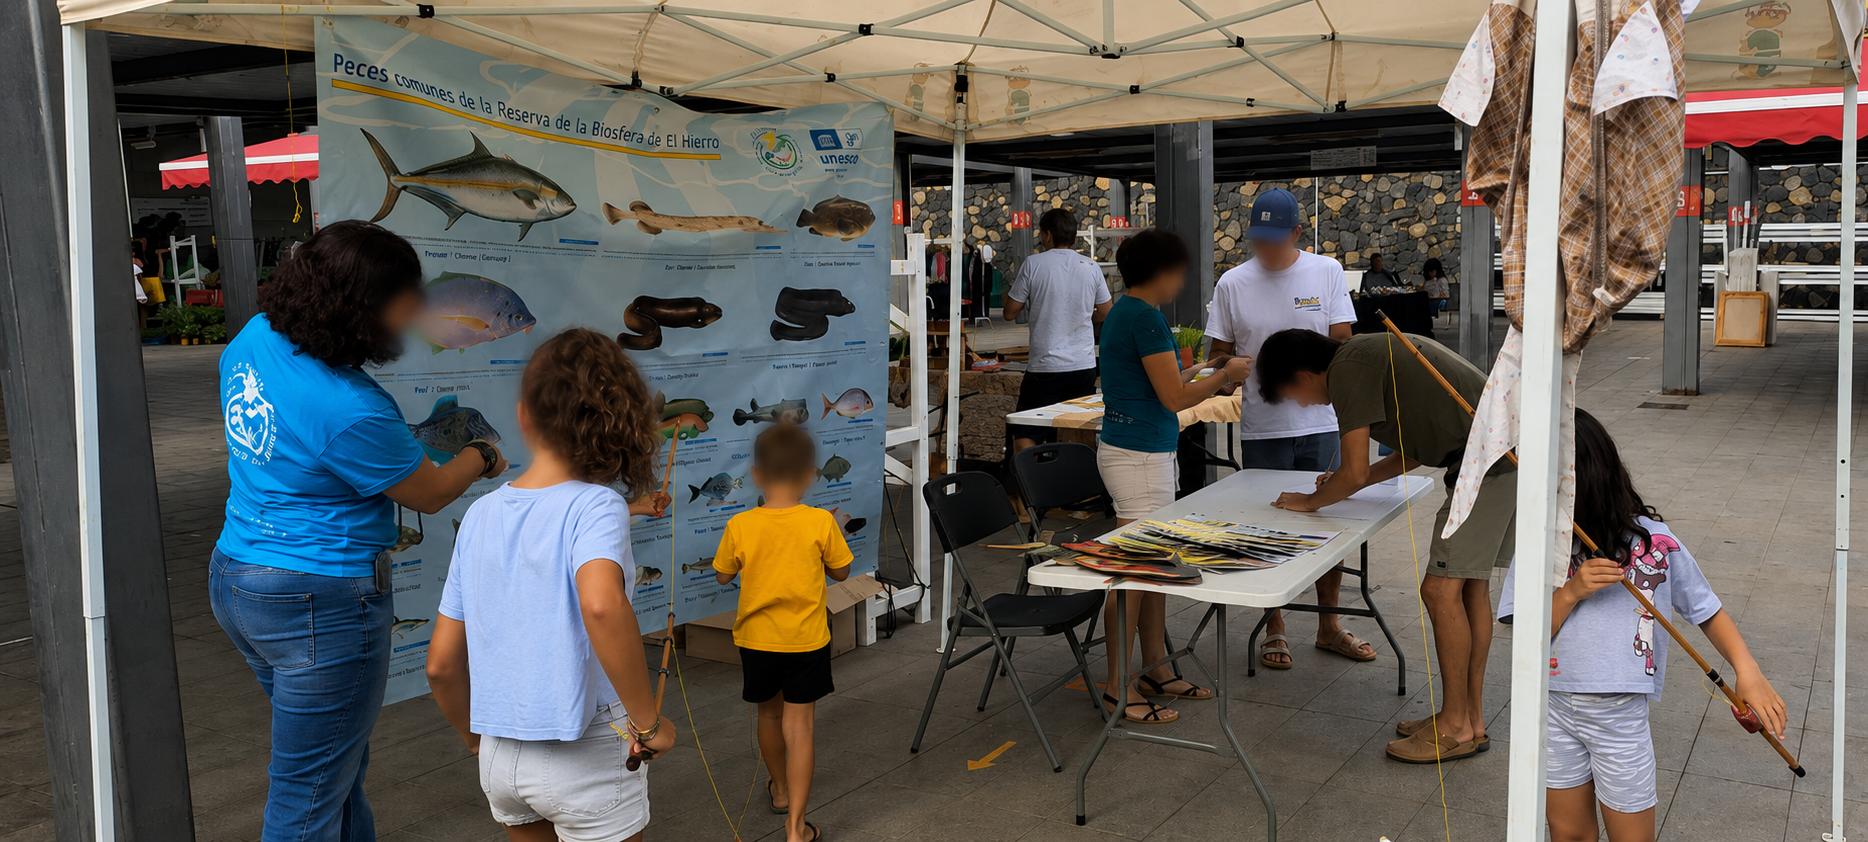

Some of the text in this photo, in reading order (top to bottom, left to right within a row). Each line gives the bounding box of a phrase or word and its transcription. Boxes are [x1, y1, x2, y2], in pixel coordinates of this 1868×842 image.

[333, 53, 720, 149] Peces comunes de la Reserva de la Biosfera de El Hierro
[819, 154, 859, 165] unesco
